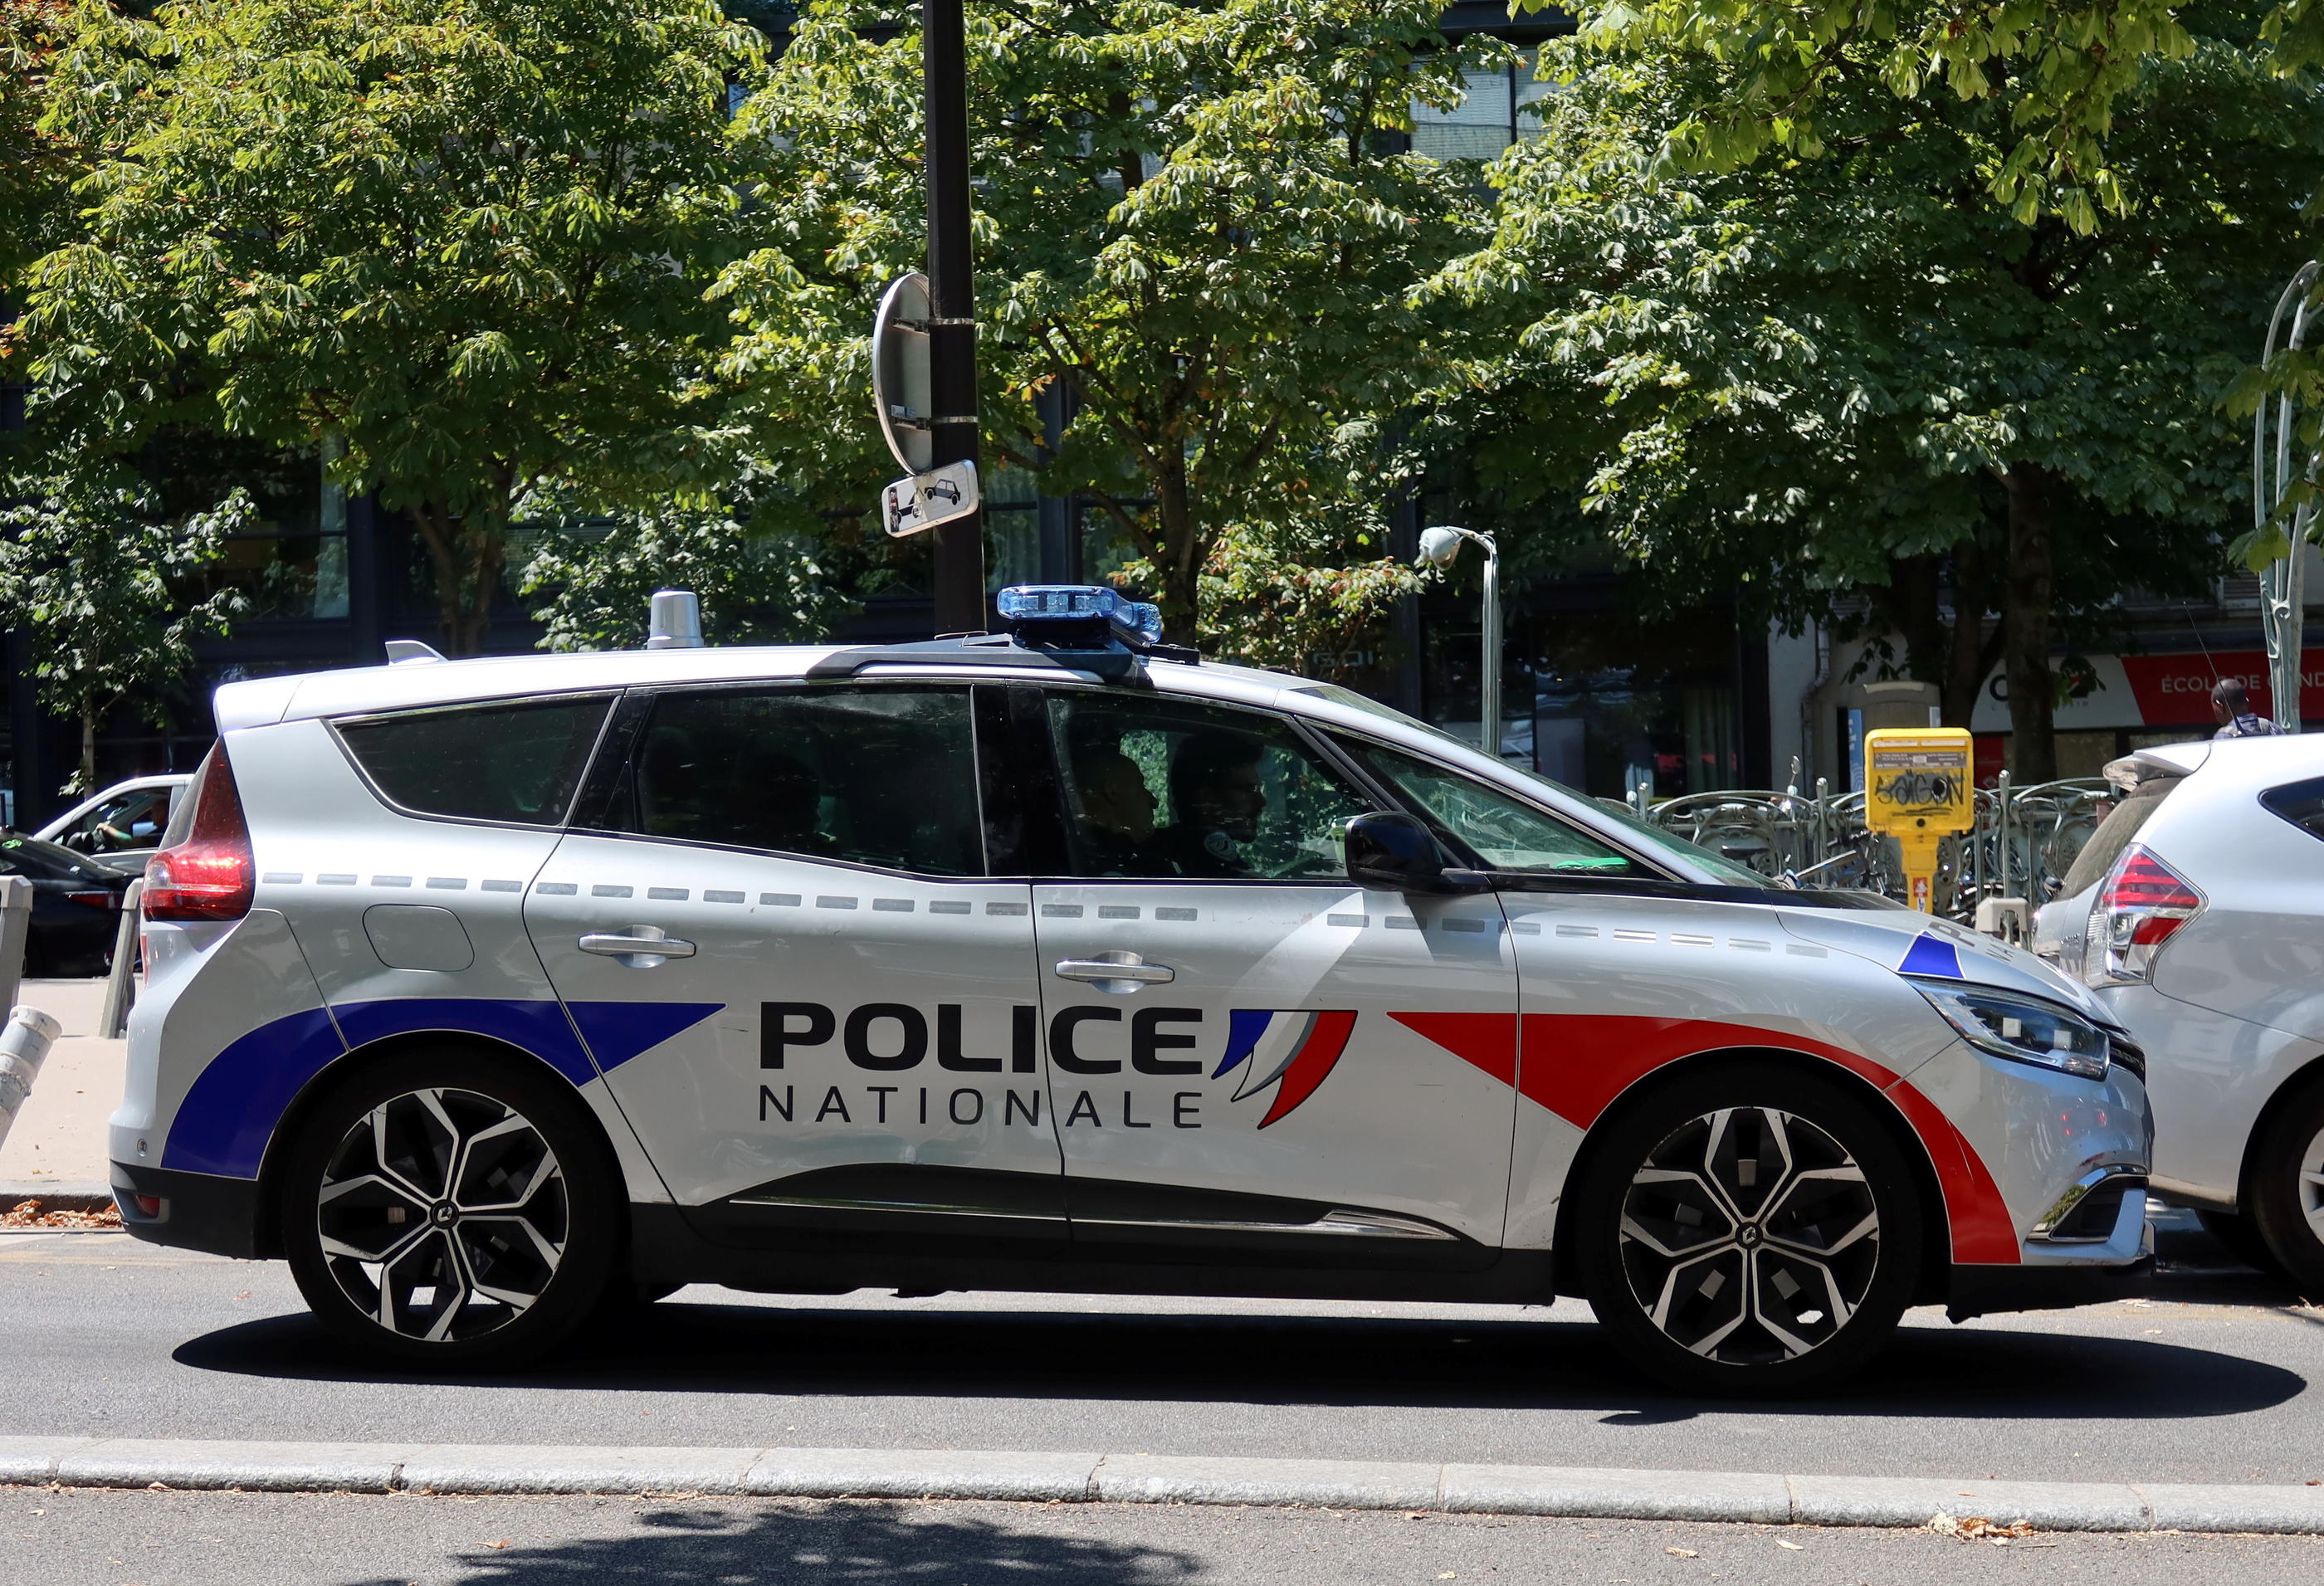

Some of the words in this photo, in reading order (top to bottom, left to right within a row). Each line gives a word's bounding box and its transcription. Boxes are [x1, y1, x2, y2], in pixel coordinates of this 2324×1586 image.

[2161, 673, 2226, 694] ÉCOL
[759, 1001, 1204, 1075] POLICE
[759, 1085, 1203, 1129] NATIONALE
